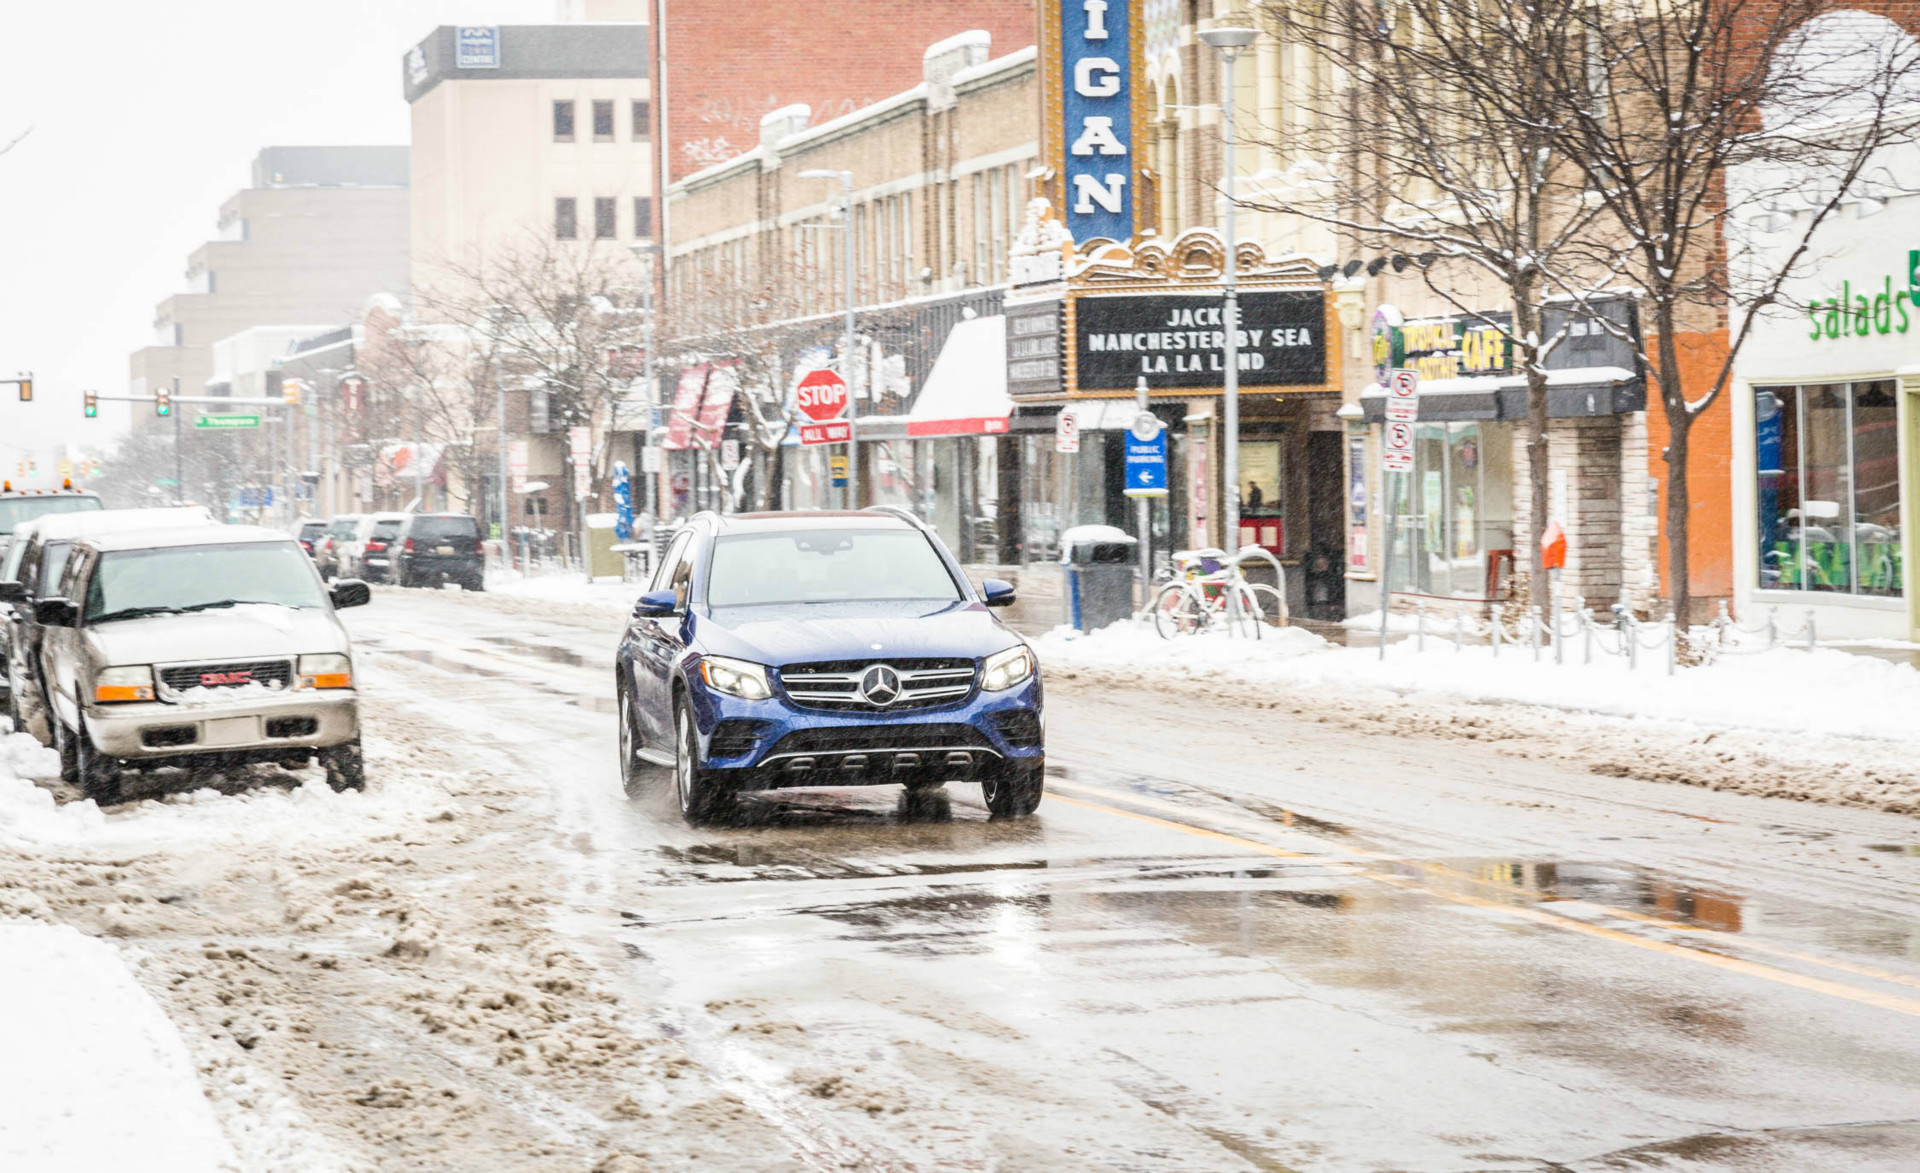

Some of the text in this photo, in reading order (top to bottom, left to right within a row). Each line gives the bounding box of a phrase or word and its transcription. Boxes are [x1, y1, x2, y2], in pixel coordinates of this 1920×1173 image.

[1071, 0, 1127, 214] IGAN
[1166, 307, 1243, 327] JACKIE
[1809, 274, 1909, 341] salads
[1088, 328, 1312, 351] MANCHESTER BY SEA
[1141, 352, 1265, 373] LA LA LND
[798, 383, 846, 407] STOP
[803, 425, 849, 441] ALL WAY
[1126, 455, 1164, 464] PARKING
[1130, 445, 1160, 454] PUBLIC
[200, 671, 252, 685] GMC
